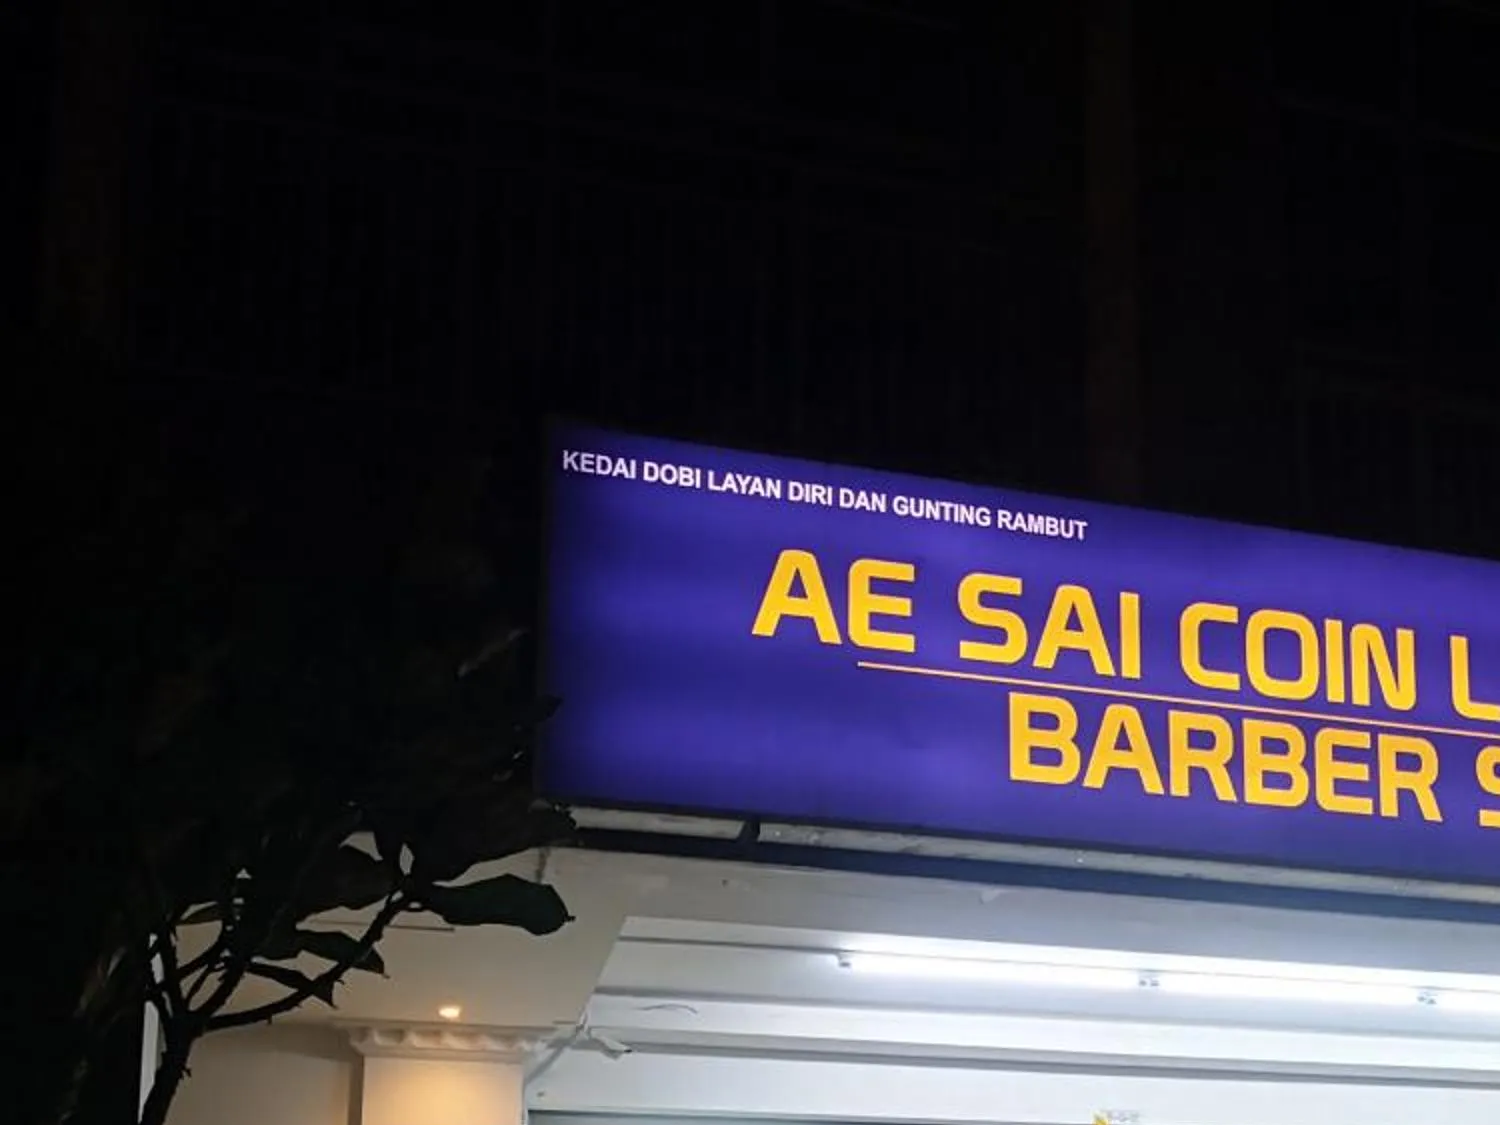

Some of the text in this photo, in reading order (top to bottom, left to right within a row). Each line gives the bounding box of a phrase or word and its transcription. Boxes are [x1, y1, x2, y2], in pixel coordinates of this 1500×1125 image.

[562, 449, 1088, 541] KEDAI DOBI LAYAN DIRI DAN GUNTING RAMBUT
[751, 549, 916, 654] AE
[957, 572, 1142, 679] SAI
[1179, 601, 1417, 711] COIN
[1008, 691, 1443, 822] BARBER
